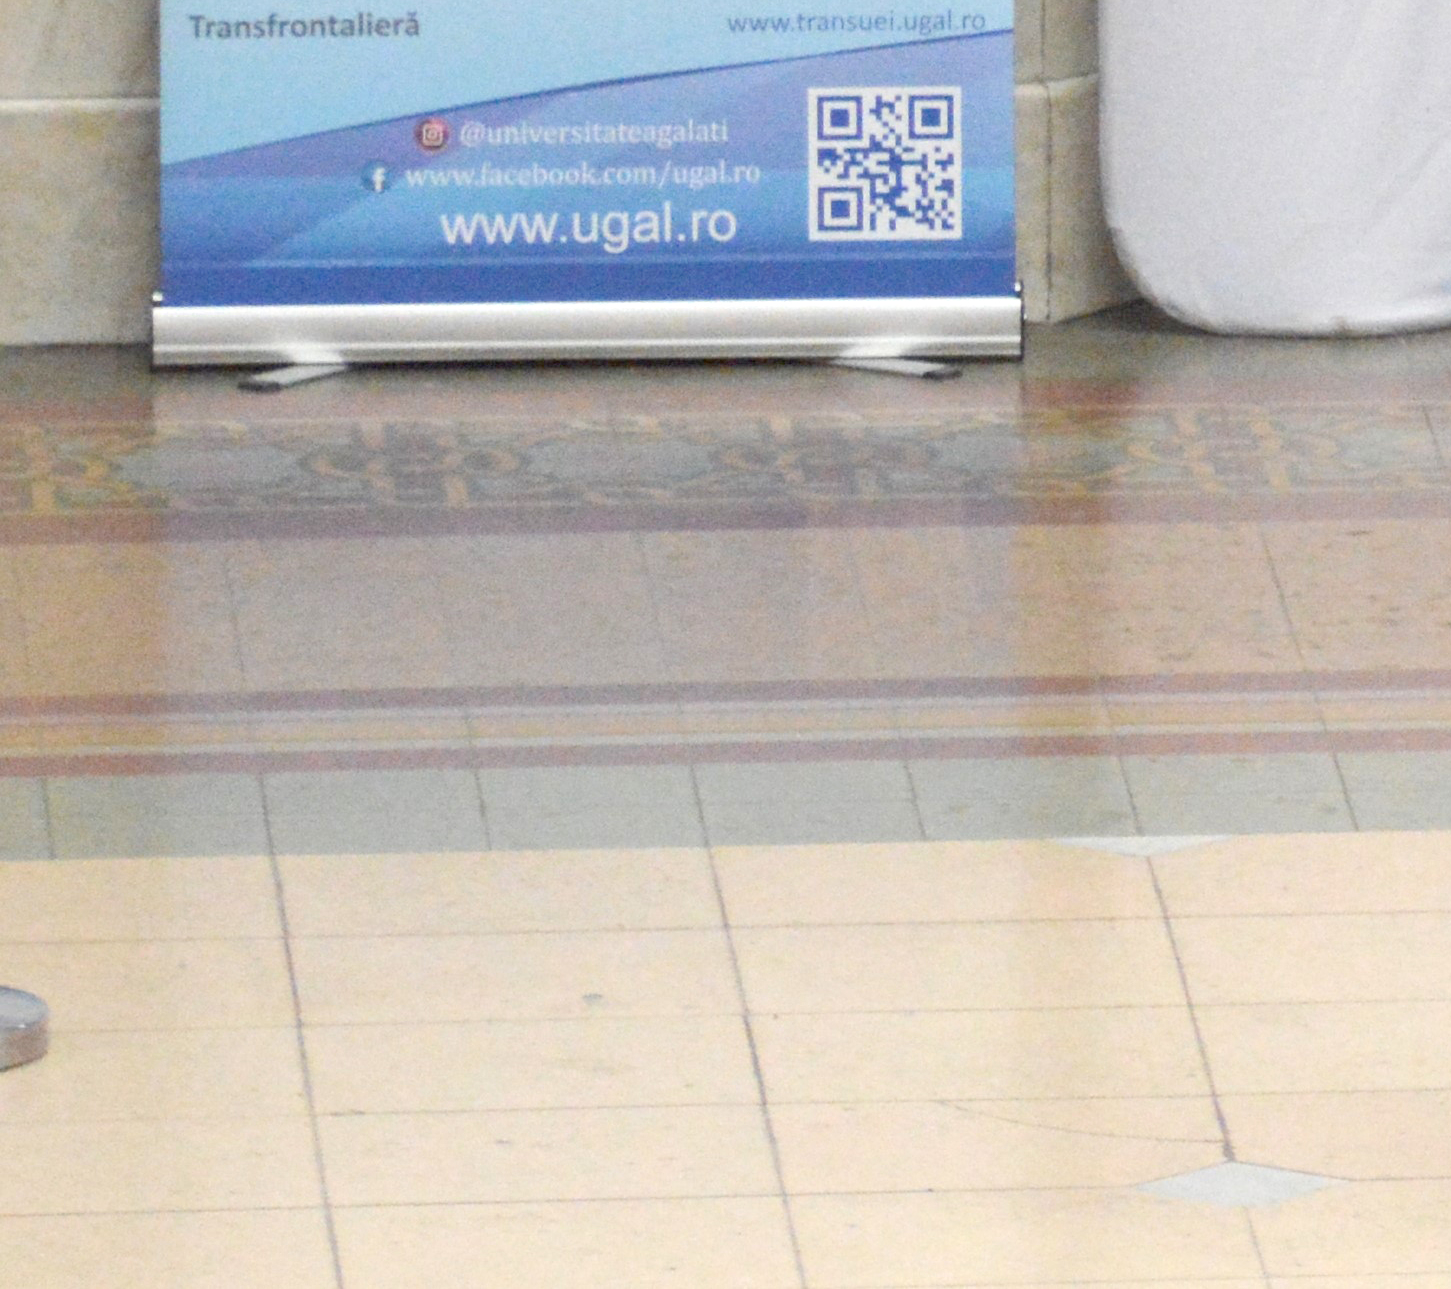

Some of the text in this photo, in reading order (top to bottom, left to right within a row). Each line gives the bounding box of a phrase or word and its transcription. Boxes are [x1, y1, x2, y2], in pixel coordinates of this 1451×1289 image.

[459, 118, 730, 149] @universitateagalati
[406, 161, 763, 191] www.facebook.com/ugal.ro
[440, 202, 737, 254] www.ugal.ro
